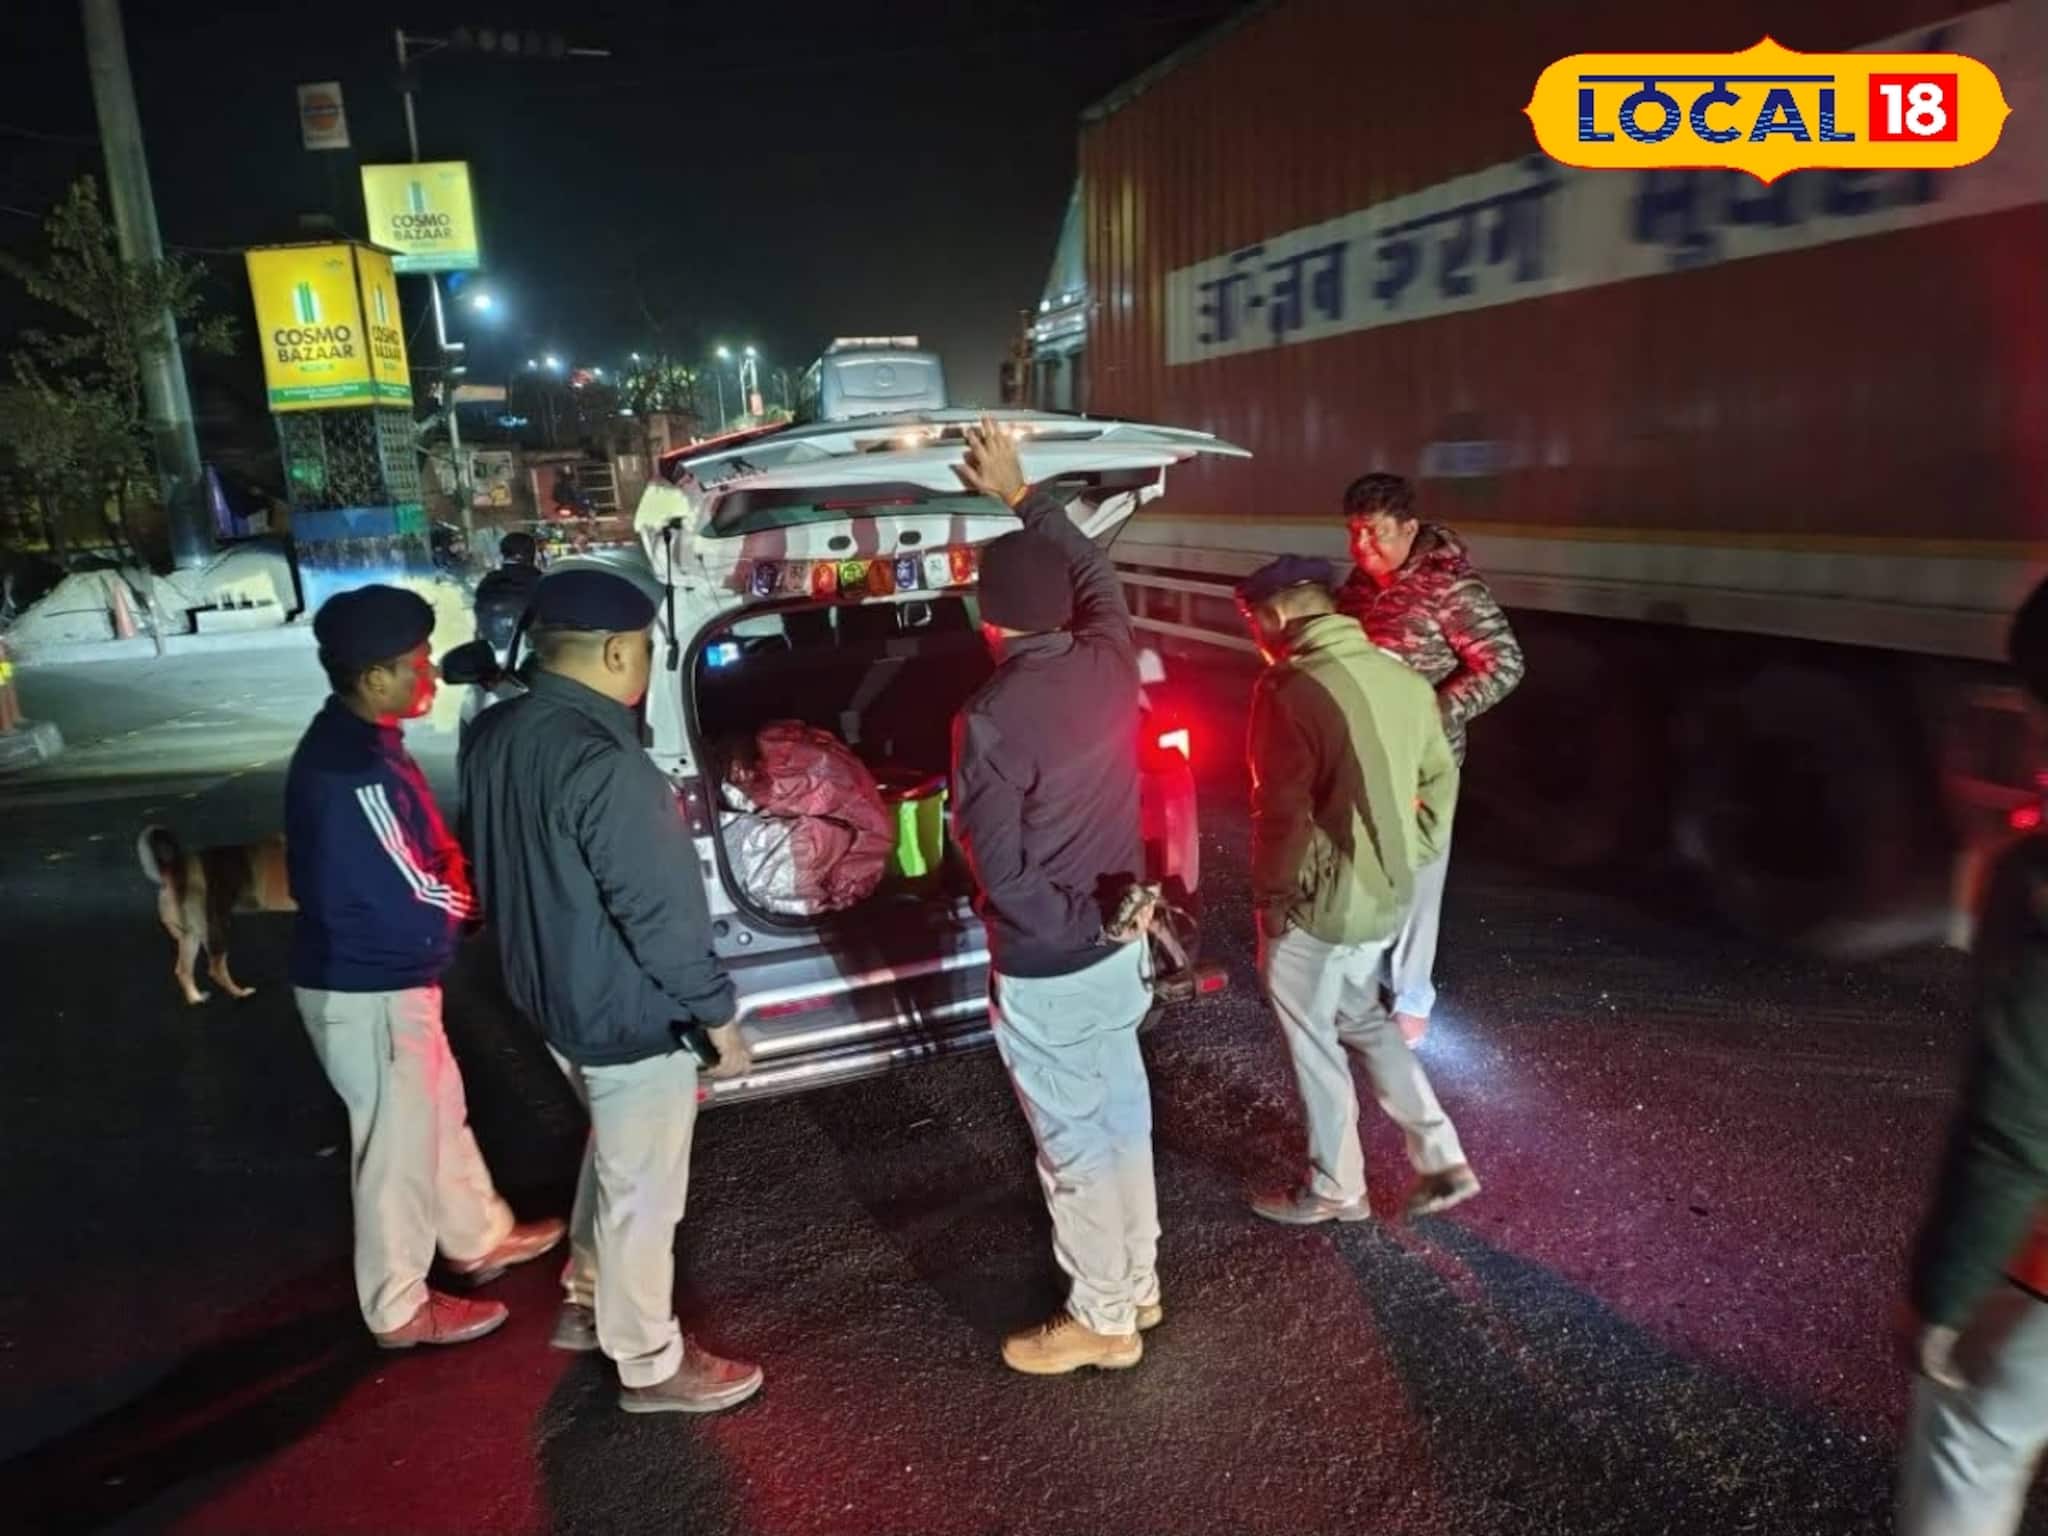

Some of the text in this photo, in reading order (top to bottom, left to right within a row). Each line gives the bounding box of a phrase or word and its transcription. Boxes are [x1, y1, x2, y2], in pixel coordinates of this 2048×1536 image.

[391, 213, 450, 229] COSMO
[393, 227, 452, 241] BAZAAR
[274, 325, 351, 346] COSMO
[278, 344, 354, 363] BAZAAR
